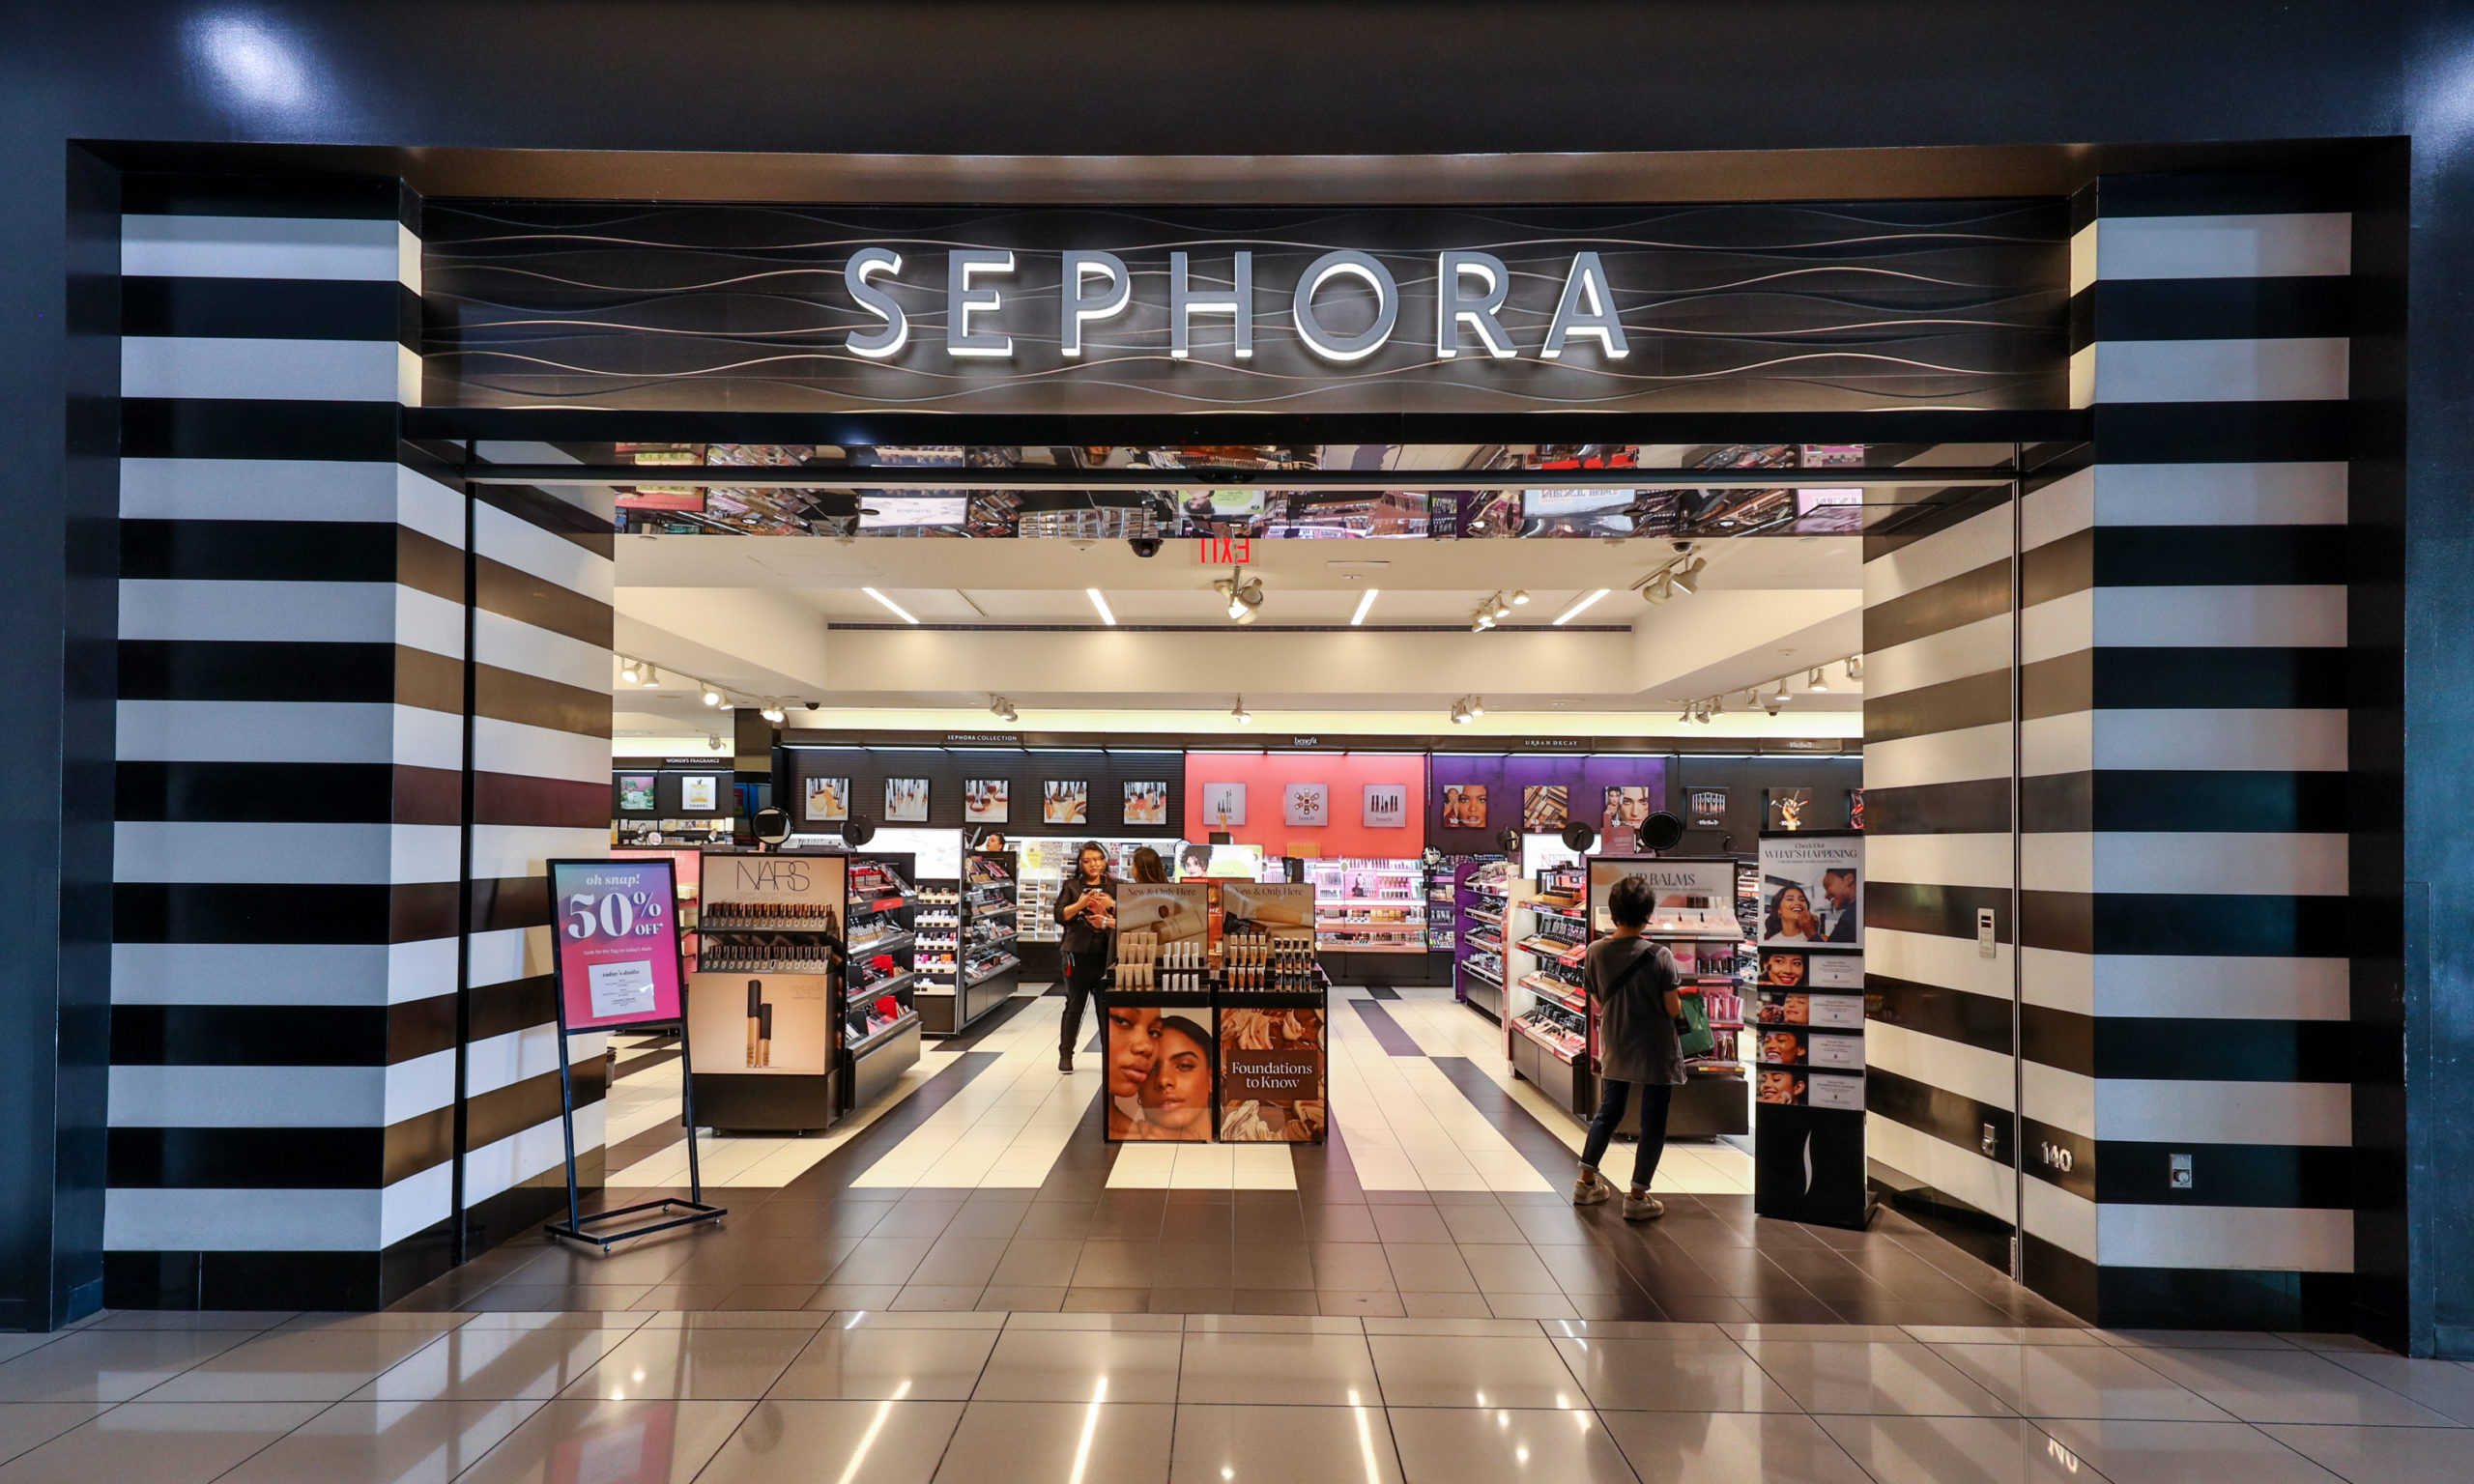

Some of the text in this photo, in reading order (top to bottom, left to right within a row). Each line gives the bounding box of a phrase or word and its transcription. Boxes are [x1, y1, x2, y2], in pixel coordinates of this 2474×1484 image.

[844, 247, 1629, 361] SEPHORA
[586, 873, 640, 887] oh snap!
[736, 860, 810, 892] NARS
[1650, 873, 1696, 887] BALMS
[1176, 888, 1196, 897] Here
[568, 891, 662, 939] 50%
[1232, 1062, 1312, 1074] Foundations
[1246, 1075, 1300, 1088] to Know
[2041, 1141, 2073, 1172] 140
